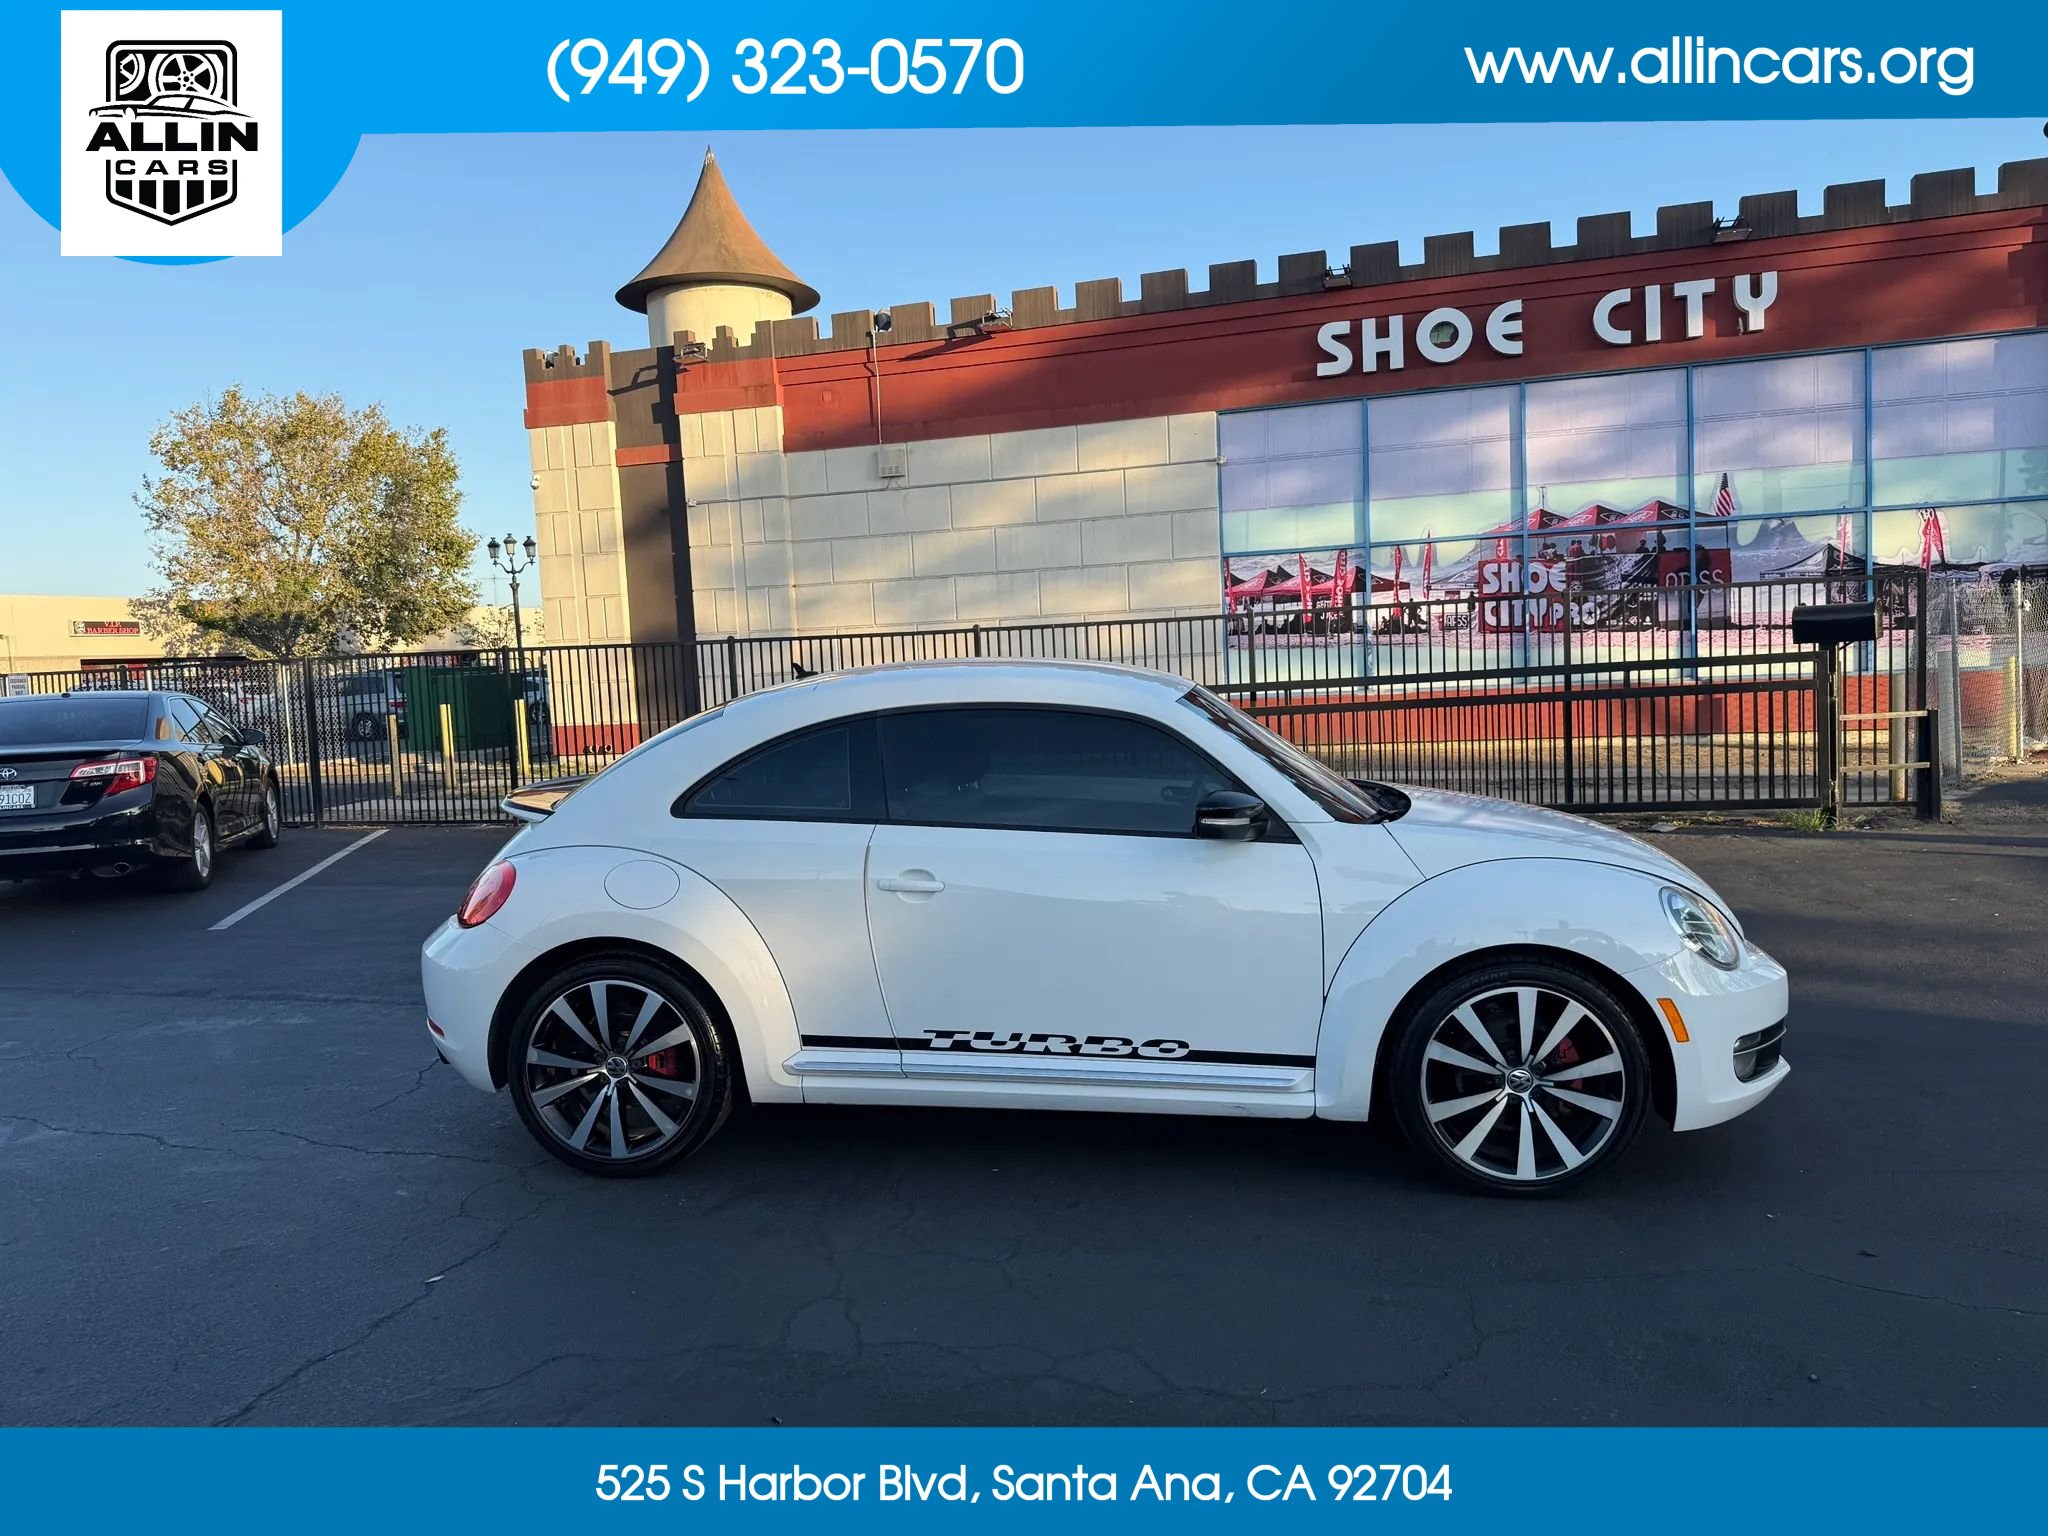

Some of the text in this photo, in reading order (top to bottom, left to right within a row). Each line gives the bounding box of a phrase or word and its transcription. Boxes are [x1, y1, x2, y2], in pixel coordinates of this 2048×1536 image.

[1316, 271, 1778, 377] SHOE CITY
[1482, 561, 1567, 594] SHOE
[1484, 598, 1601, 627] CITY PRO
[923, 1029, 1190, 1058] TURBO
